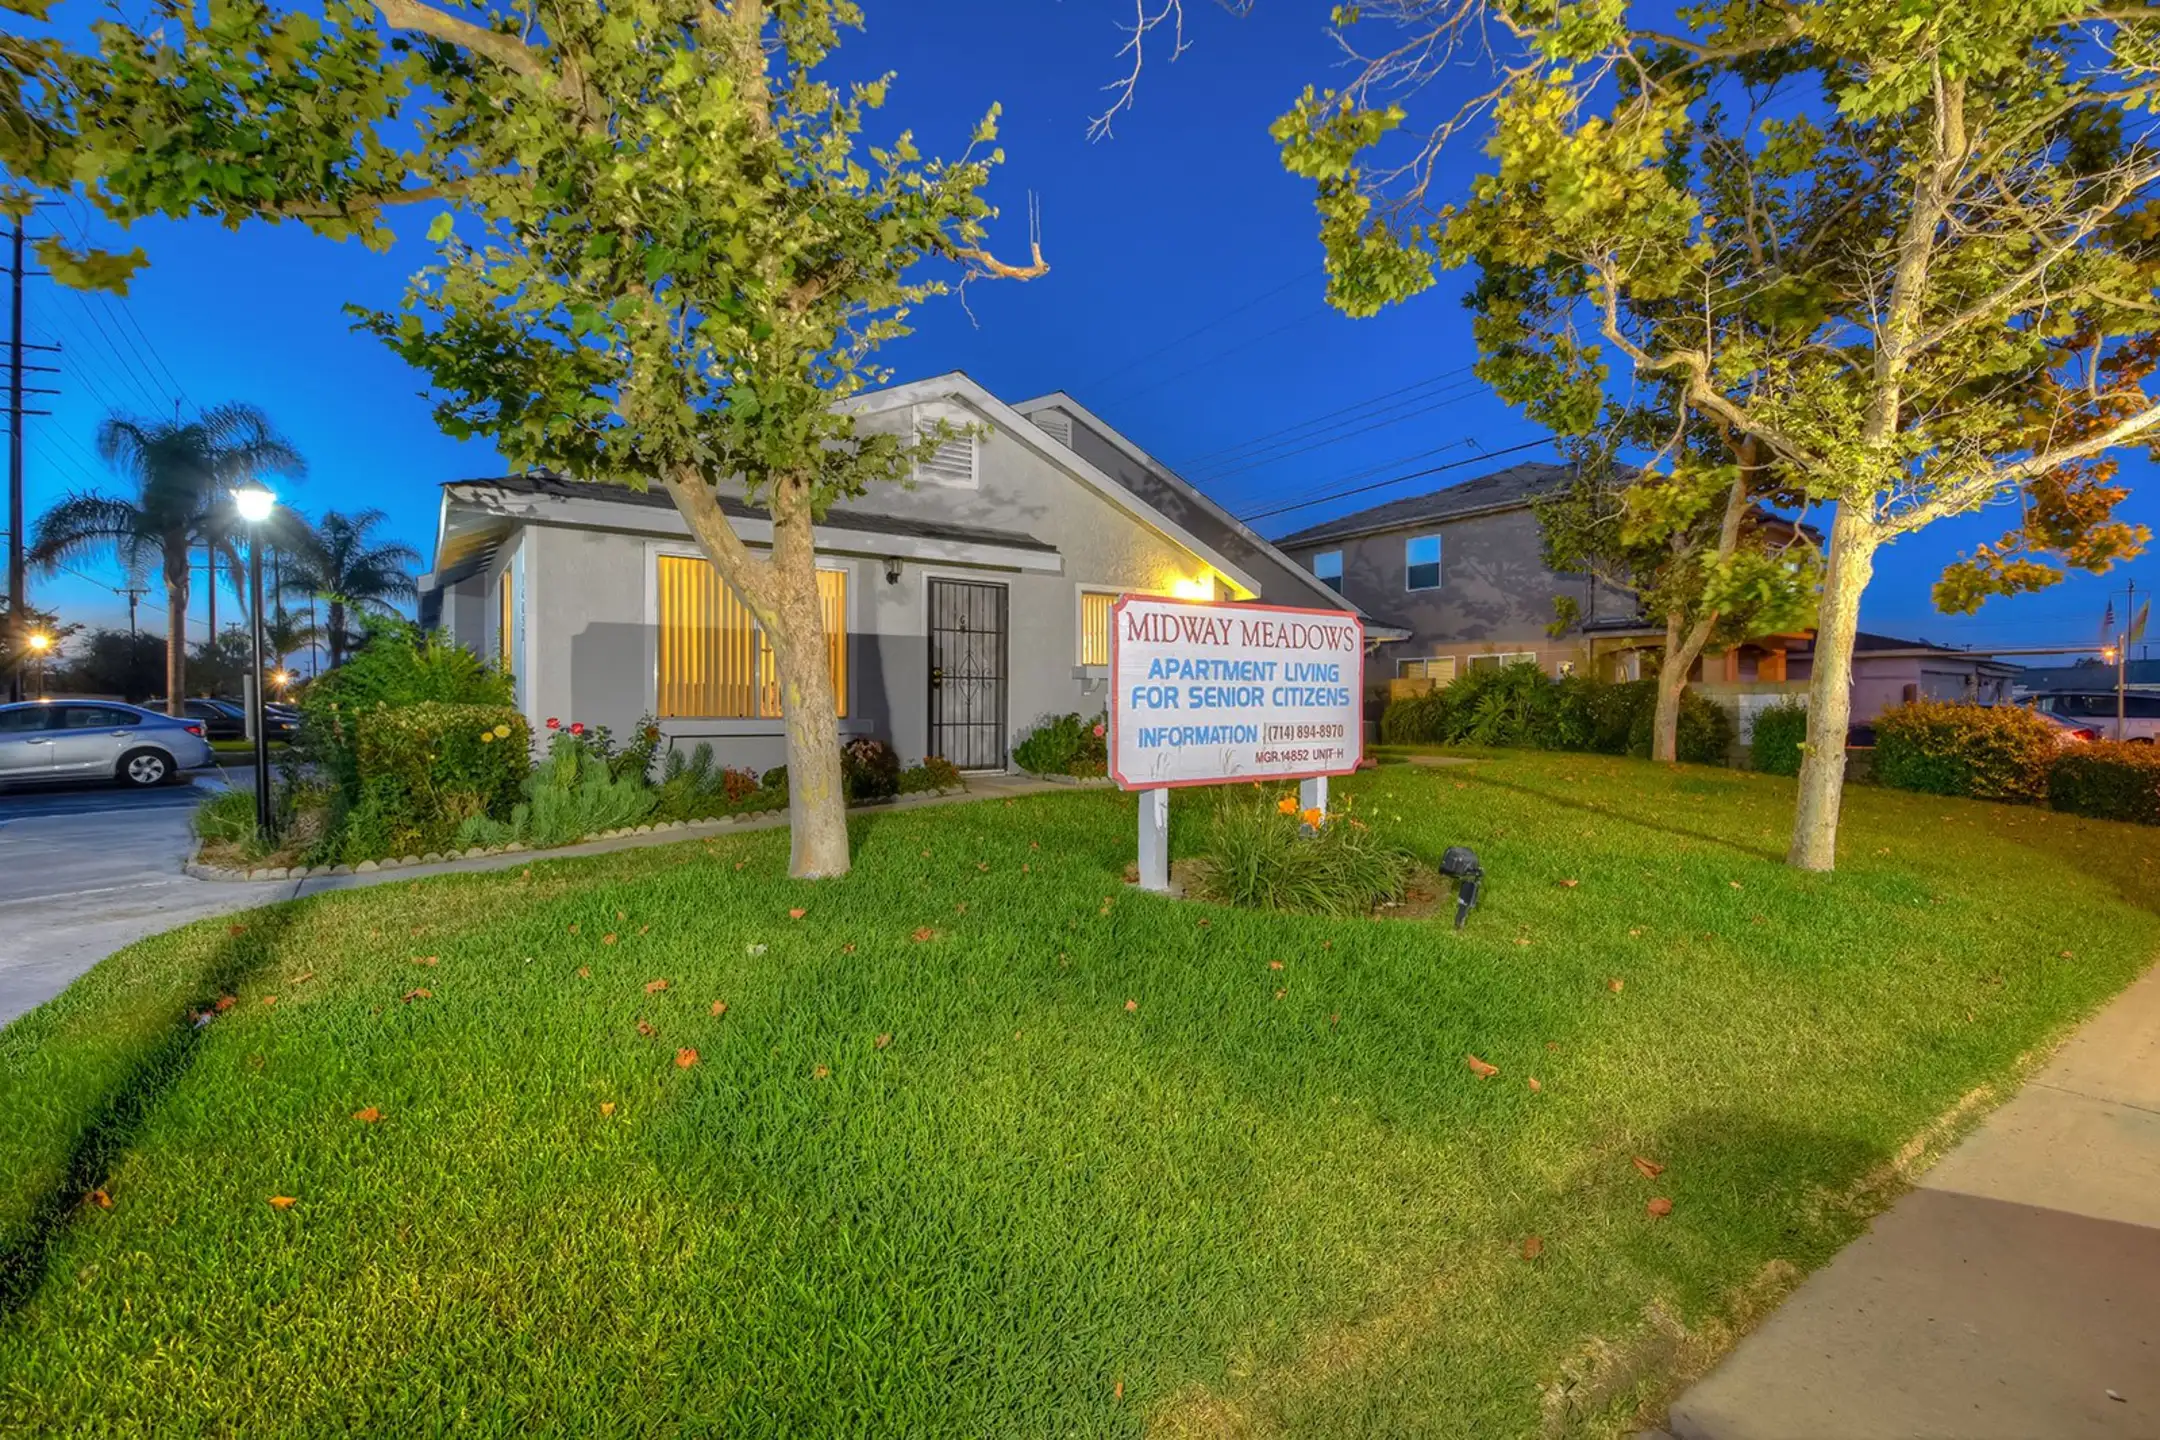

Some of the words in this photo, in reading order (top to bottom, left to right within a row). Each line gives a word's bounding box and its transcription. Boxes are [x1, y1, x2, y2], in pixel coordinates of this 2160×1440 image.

[1126, 611, 1233, 645] MIDWAY
[1240, 620, 1354, 652] MEADOWS
[1148, 658, 1277, 682] APARTMENT
[1285, 663, 1339, 682] LIVING
[1131, 686, 1180, 709] FOR
[1188, 687, 1264, 708] SENIOR
[1272, 687, 1350, 707] CITIZENS
[1138, 724, 1257, 748] INFORMATION
[1268, 725, 1294, 741] (714)
[1297, 724, 1344, 739] 894-8970
